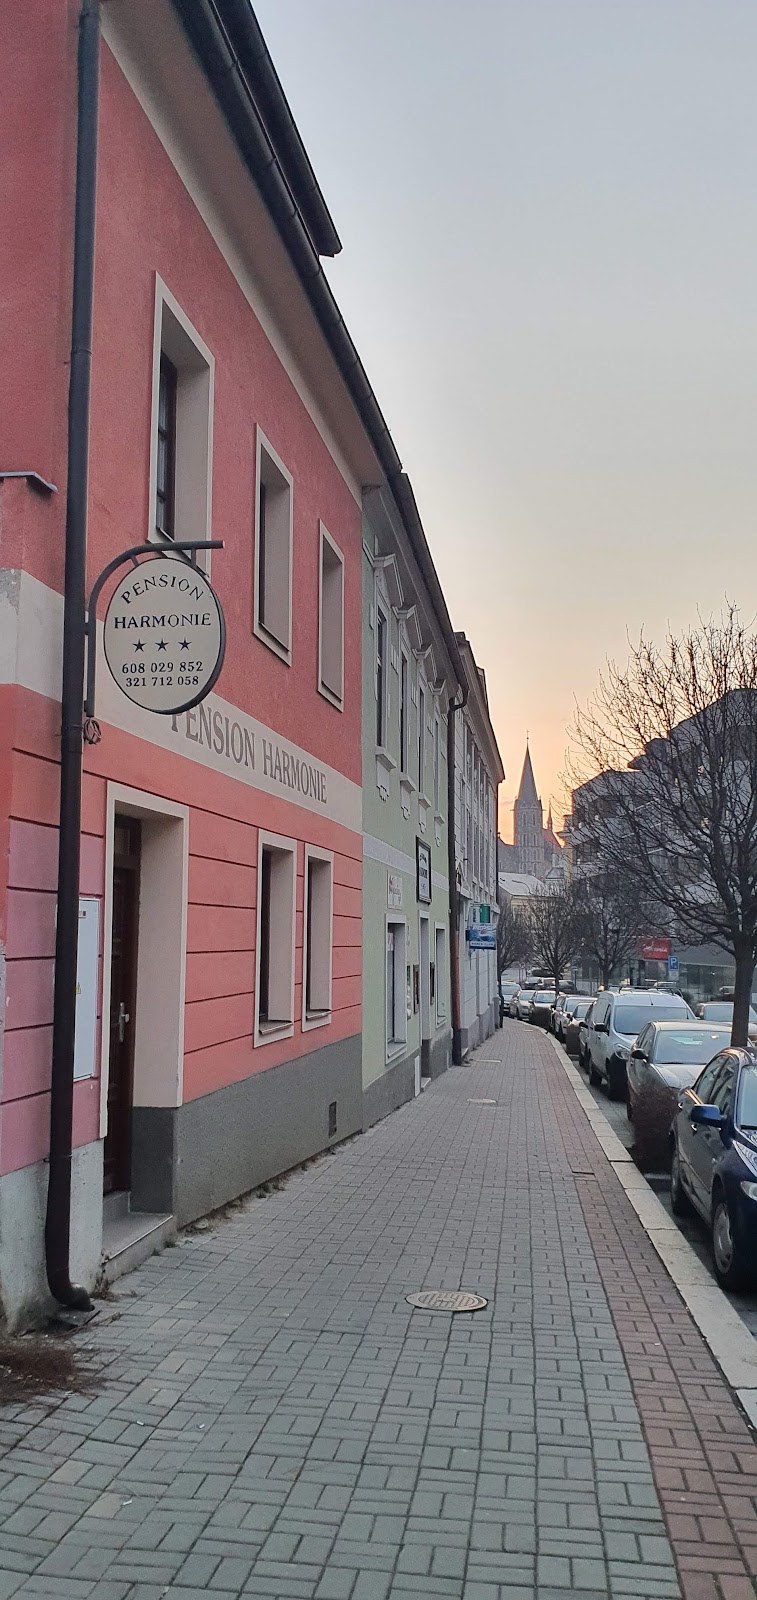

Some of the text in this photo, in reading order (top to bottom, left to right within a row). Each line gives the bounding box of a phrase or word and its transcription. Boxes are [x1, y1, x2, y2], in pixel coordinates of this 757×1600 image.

[121, 573, 204, 605] PENSION
[114, 612, 211, 629] HARMONIE
[121, 660, 204, 674] 608 029 852
[125, 675, 199, 687] 321 712 058
[262, 739, 327, 803] HARMONIE
